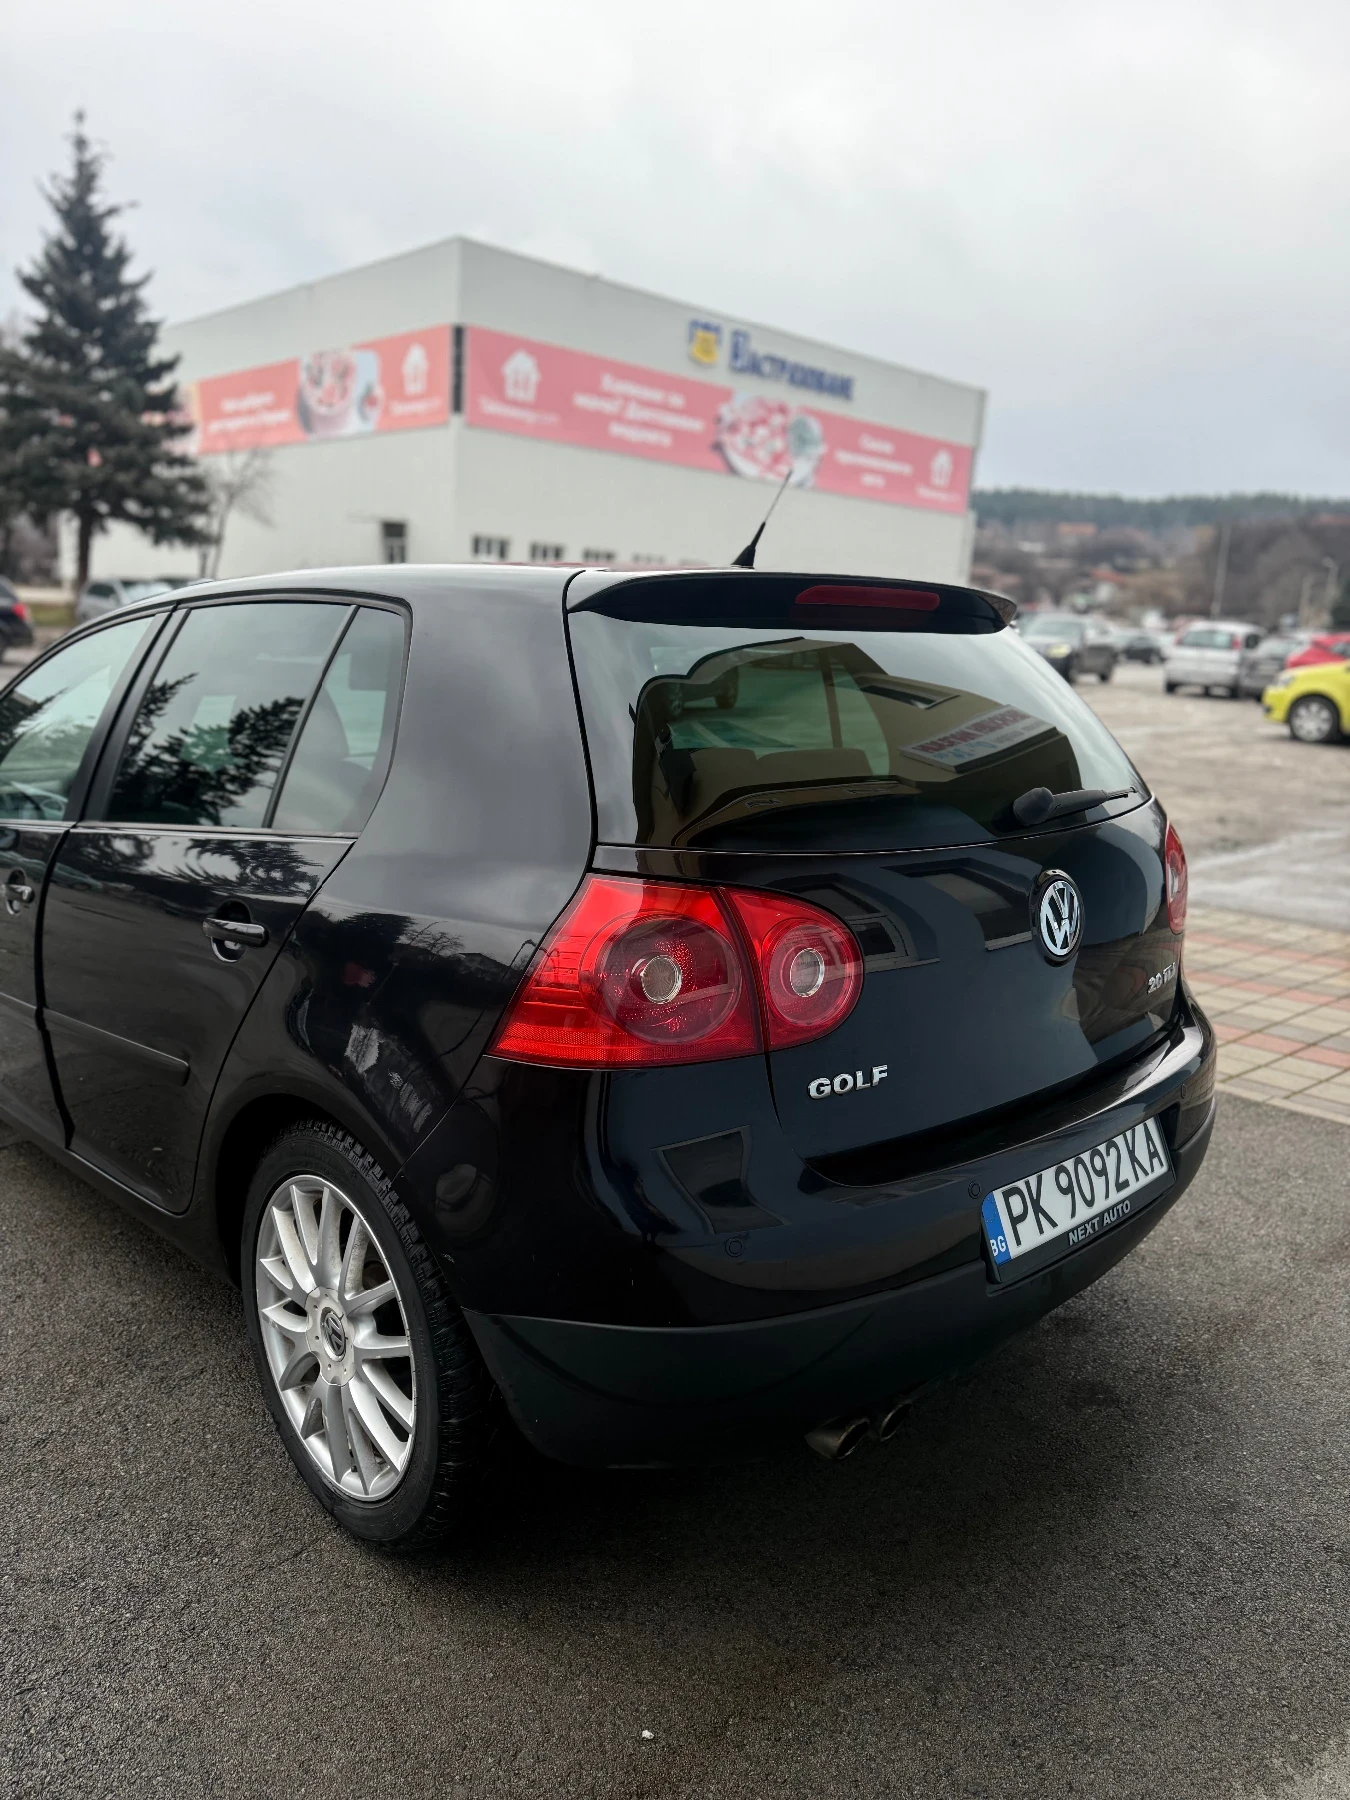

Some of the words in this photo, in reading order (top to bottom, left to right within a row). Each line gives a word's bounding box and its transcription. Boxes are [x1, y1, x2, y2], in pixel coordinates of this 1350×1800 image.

[807, 1064, 889, 1100] GOLF
[1001, 1173, 1058, 1247] PK
[1068, 1217, 1100, 1246] NEXT
[1102, 1199, 1131, 1228] AUTO
[990, 1237, 1007, 1257] BG
